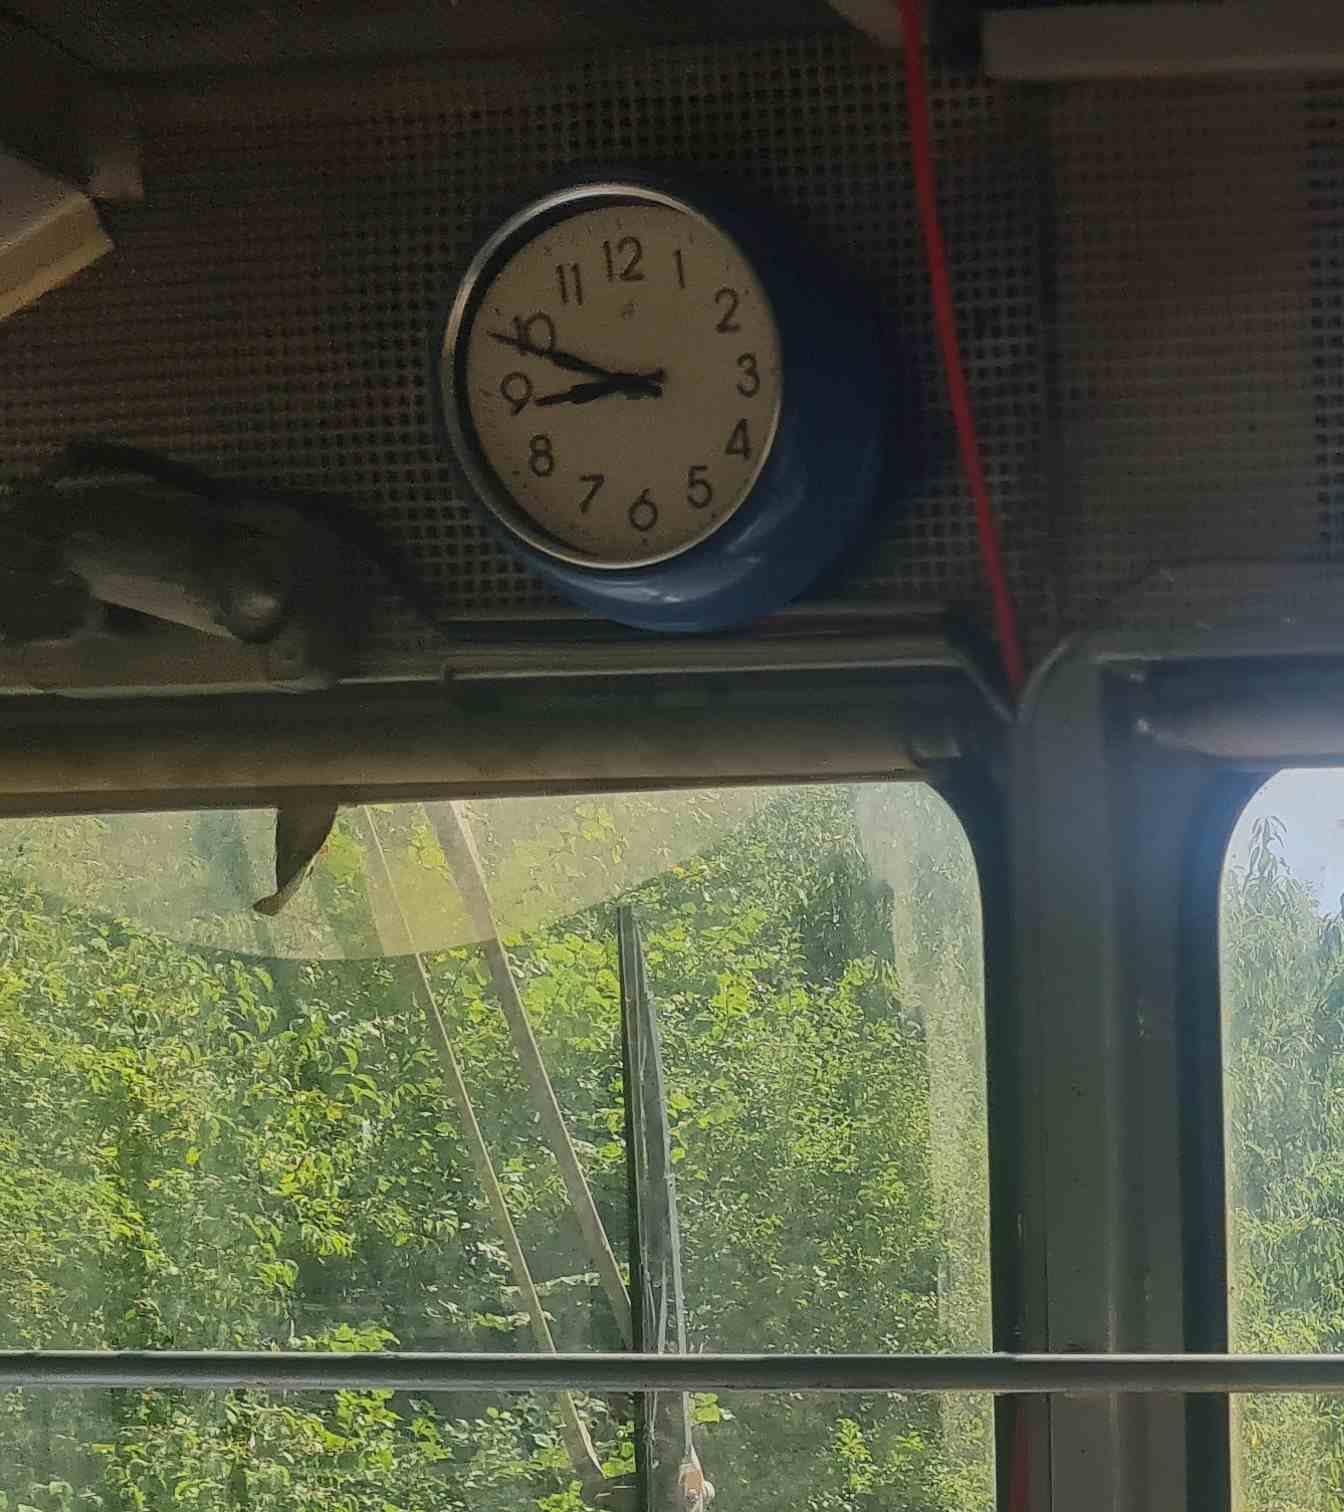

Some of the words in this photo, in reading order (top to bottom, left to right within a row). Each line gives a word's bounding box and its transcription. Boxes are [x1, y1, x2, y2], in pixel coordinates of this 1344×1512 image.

[602, 236, 645, 283] 12
[672, 248, 687, 289] 1
[555, 263, 583, 306] 11
[715, 287, 741, 333] 2
[512, 311, 557, 355] 10
[500, 371, 533, 416] 9
[736, 352, 761, 398] 3
[528, 434, 555, 478] 8
[725, 418, 753, 461] 4
[580, 474, 605, 513] 7
[687, 465, 713, 509] 5
[629, 488, 658, 532] 6
